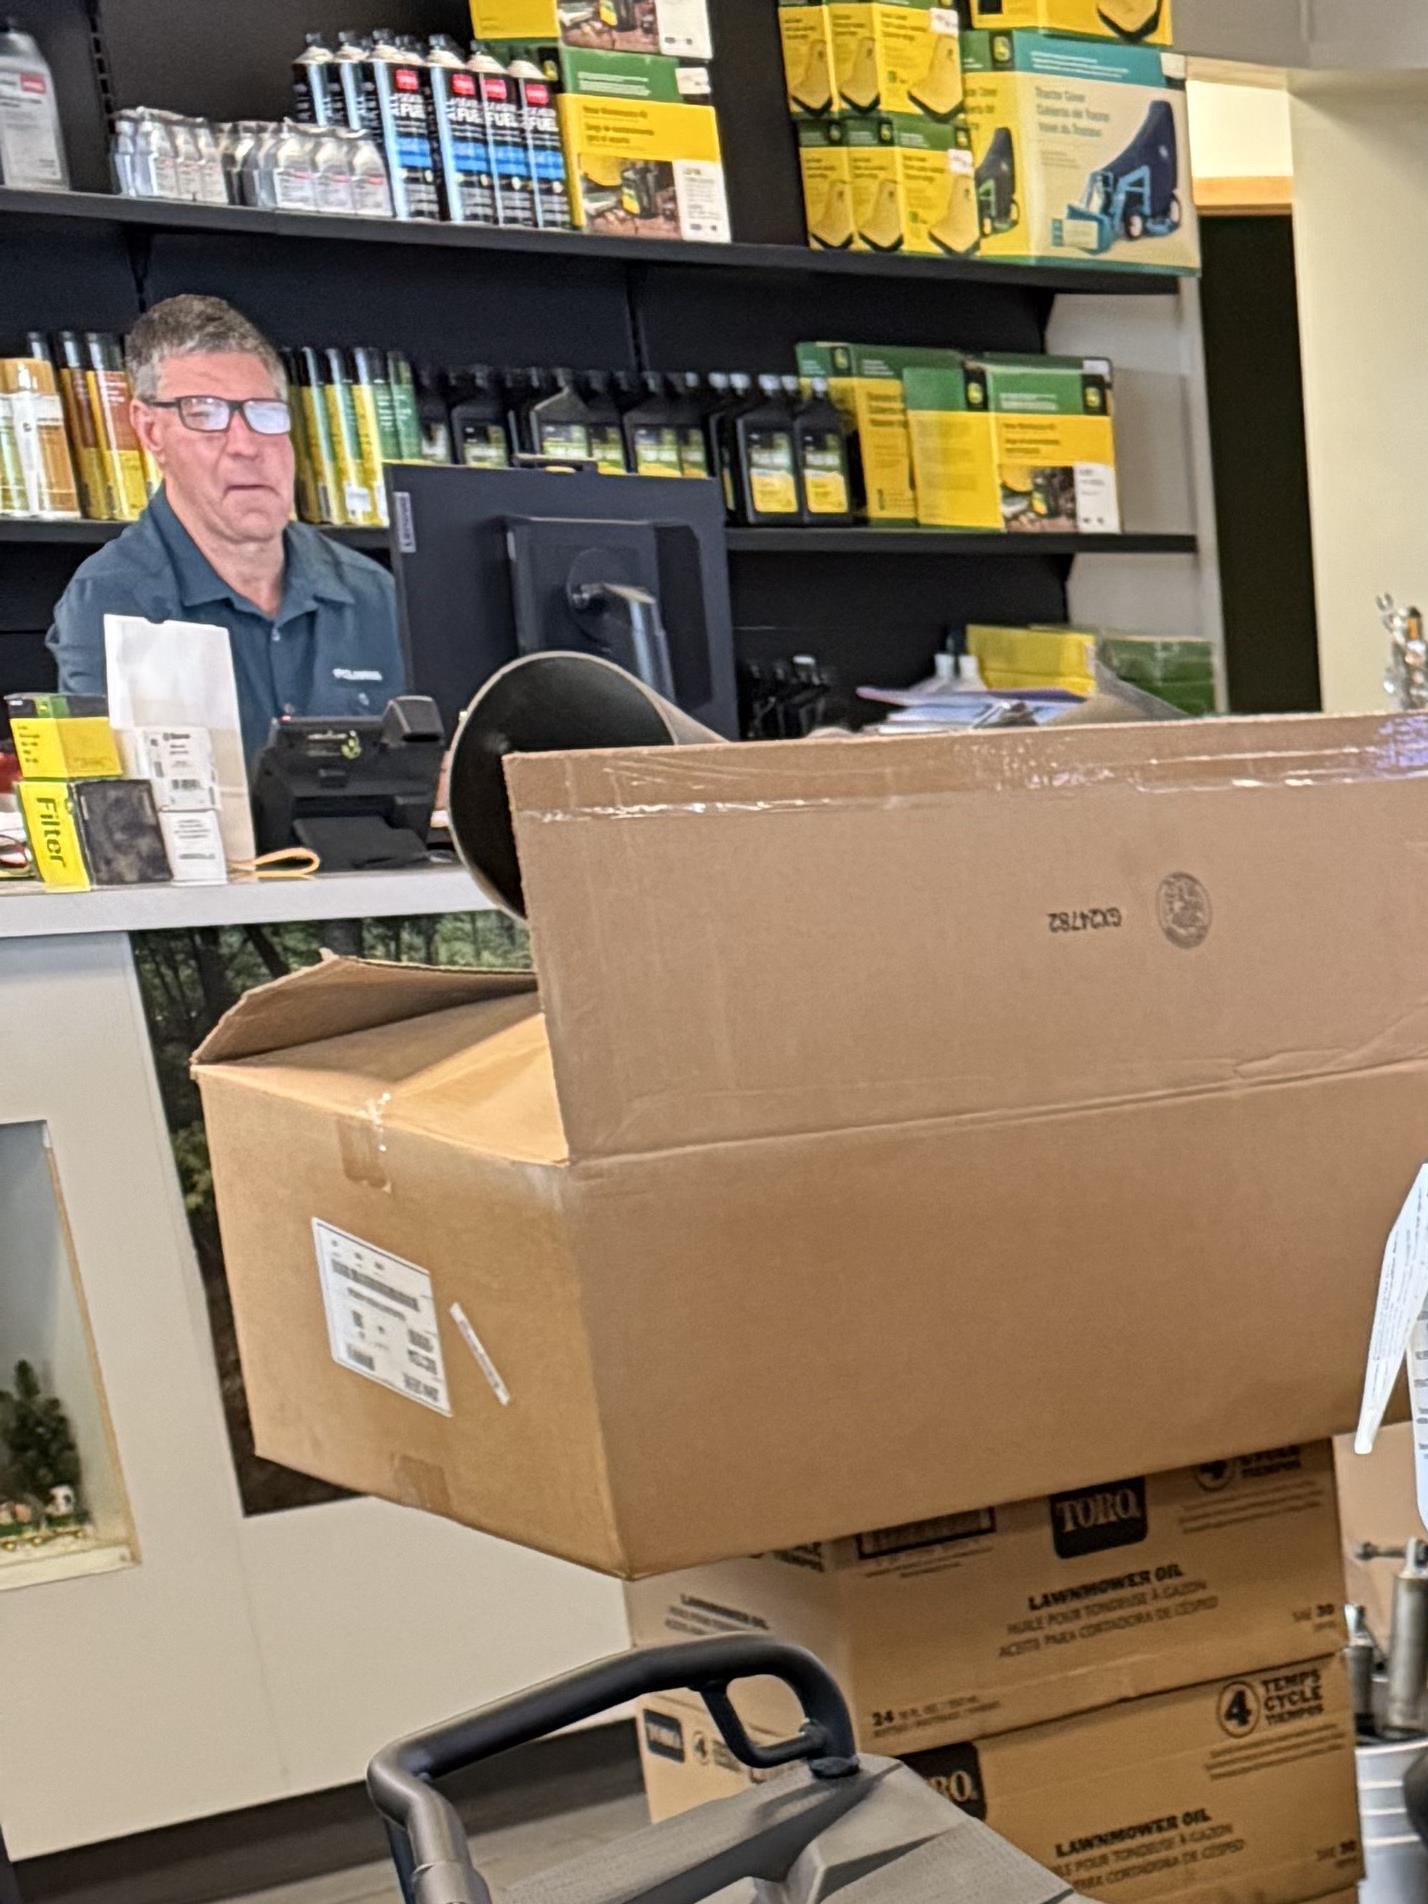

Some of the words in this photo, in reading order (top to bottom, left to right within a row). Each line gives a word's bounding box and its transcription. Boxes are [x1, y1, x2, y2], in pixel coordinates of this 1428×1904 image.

[36, 797, 66, 867] Filter
[1056, 1488, 1143, 1533] TORO
[1028, 1569, 1151, 1611] LAWNMOWER
[1154, 1563, 1184, 1582] OIL
[872, 1710, 895, 1727] 24
[1224, 1689, 1252, 1728] 4
[1261, 1669, 1322, 1694] TEMPS
[1264, 1686, 1323, 1712] CYCLE
[1055, 1814, 1178, 1858] LAWNMOWER
[1182, 1808, 1213, 1827] OIL
